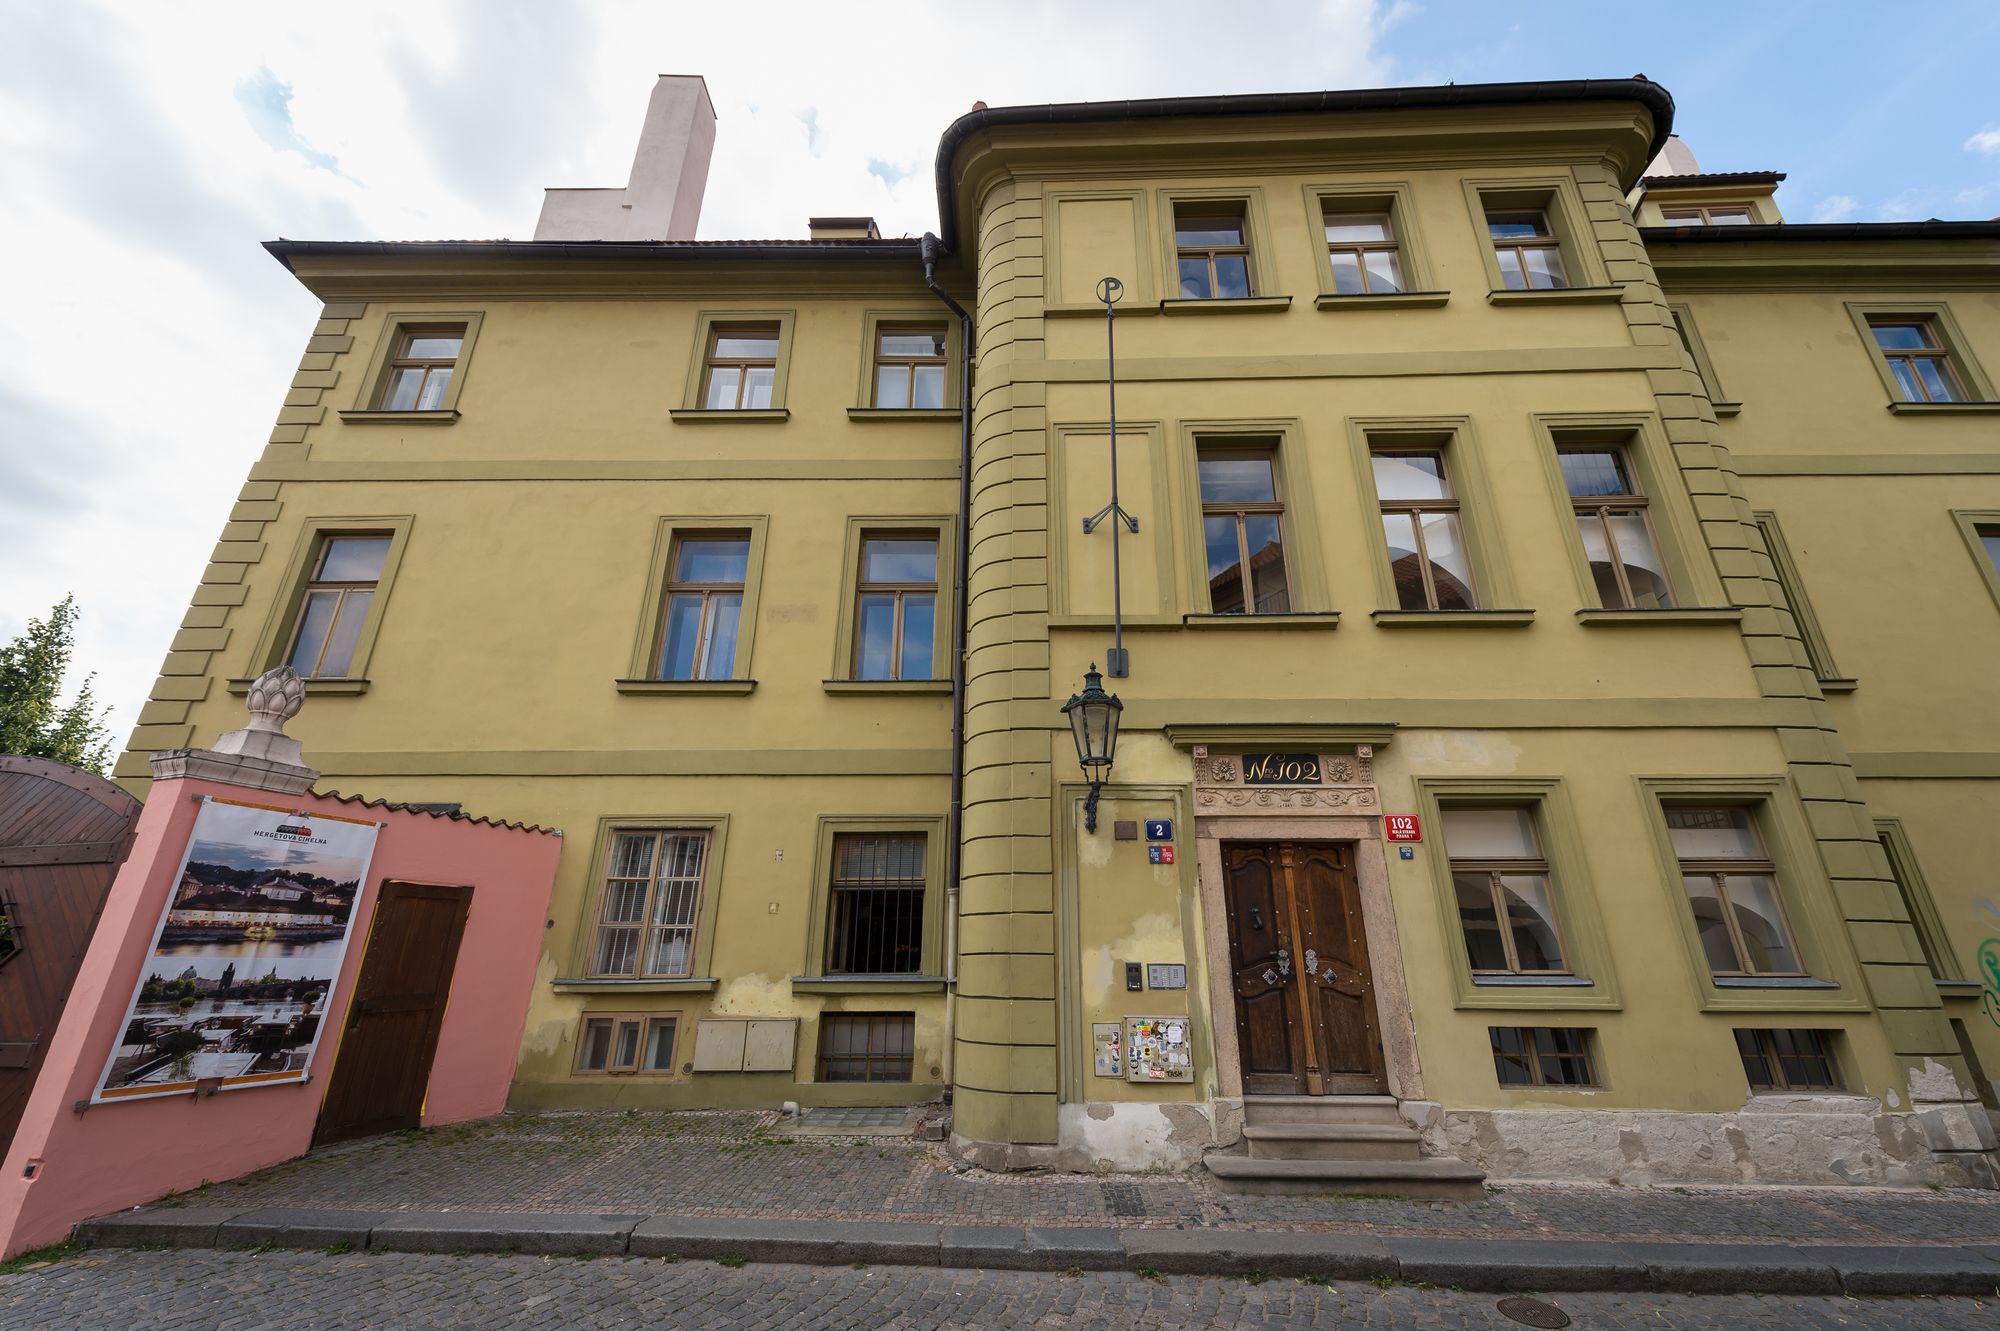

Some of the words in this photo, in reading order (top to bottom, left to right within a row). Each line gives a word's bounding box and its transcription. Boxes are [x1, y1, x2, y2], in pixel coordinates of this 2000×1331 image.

[1104, 278, 1121, 304] P
[1273, 754, 1320, 780] 102
[1156, 824, 1163, 836] 2
[1392, 817, 1413, 830] 102
[253, 830, 297, 841] HERGETOVA
[298, 835, 327, 845] CIHELNA
